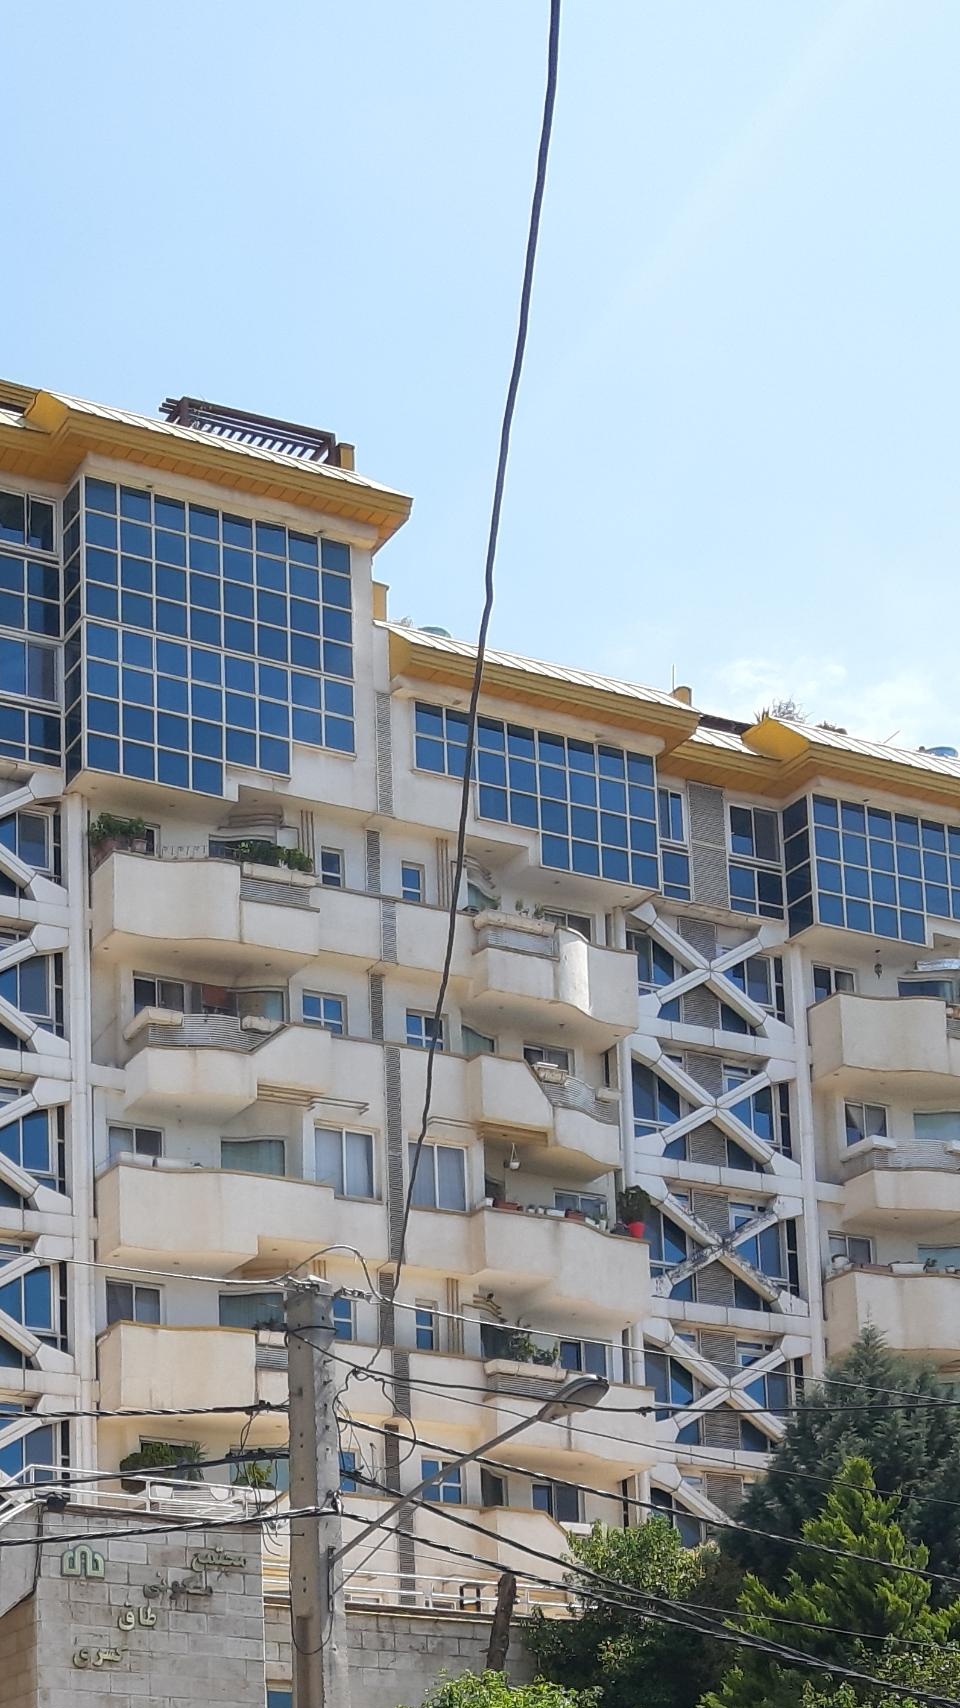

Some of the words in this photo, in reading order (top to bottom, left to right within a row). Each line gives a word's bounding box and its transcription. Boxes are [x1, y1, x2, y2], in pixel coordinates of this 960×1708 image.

[191, 1546, 246, 1573] مجتمع
[118, 1601, 157, 1631] طاق
[73, 1646, 128, 1669] کسری
